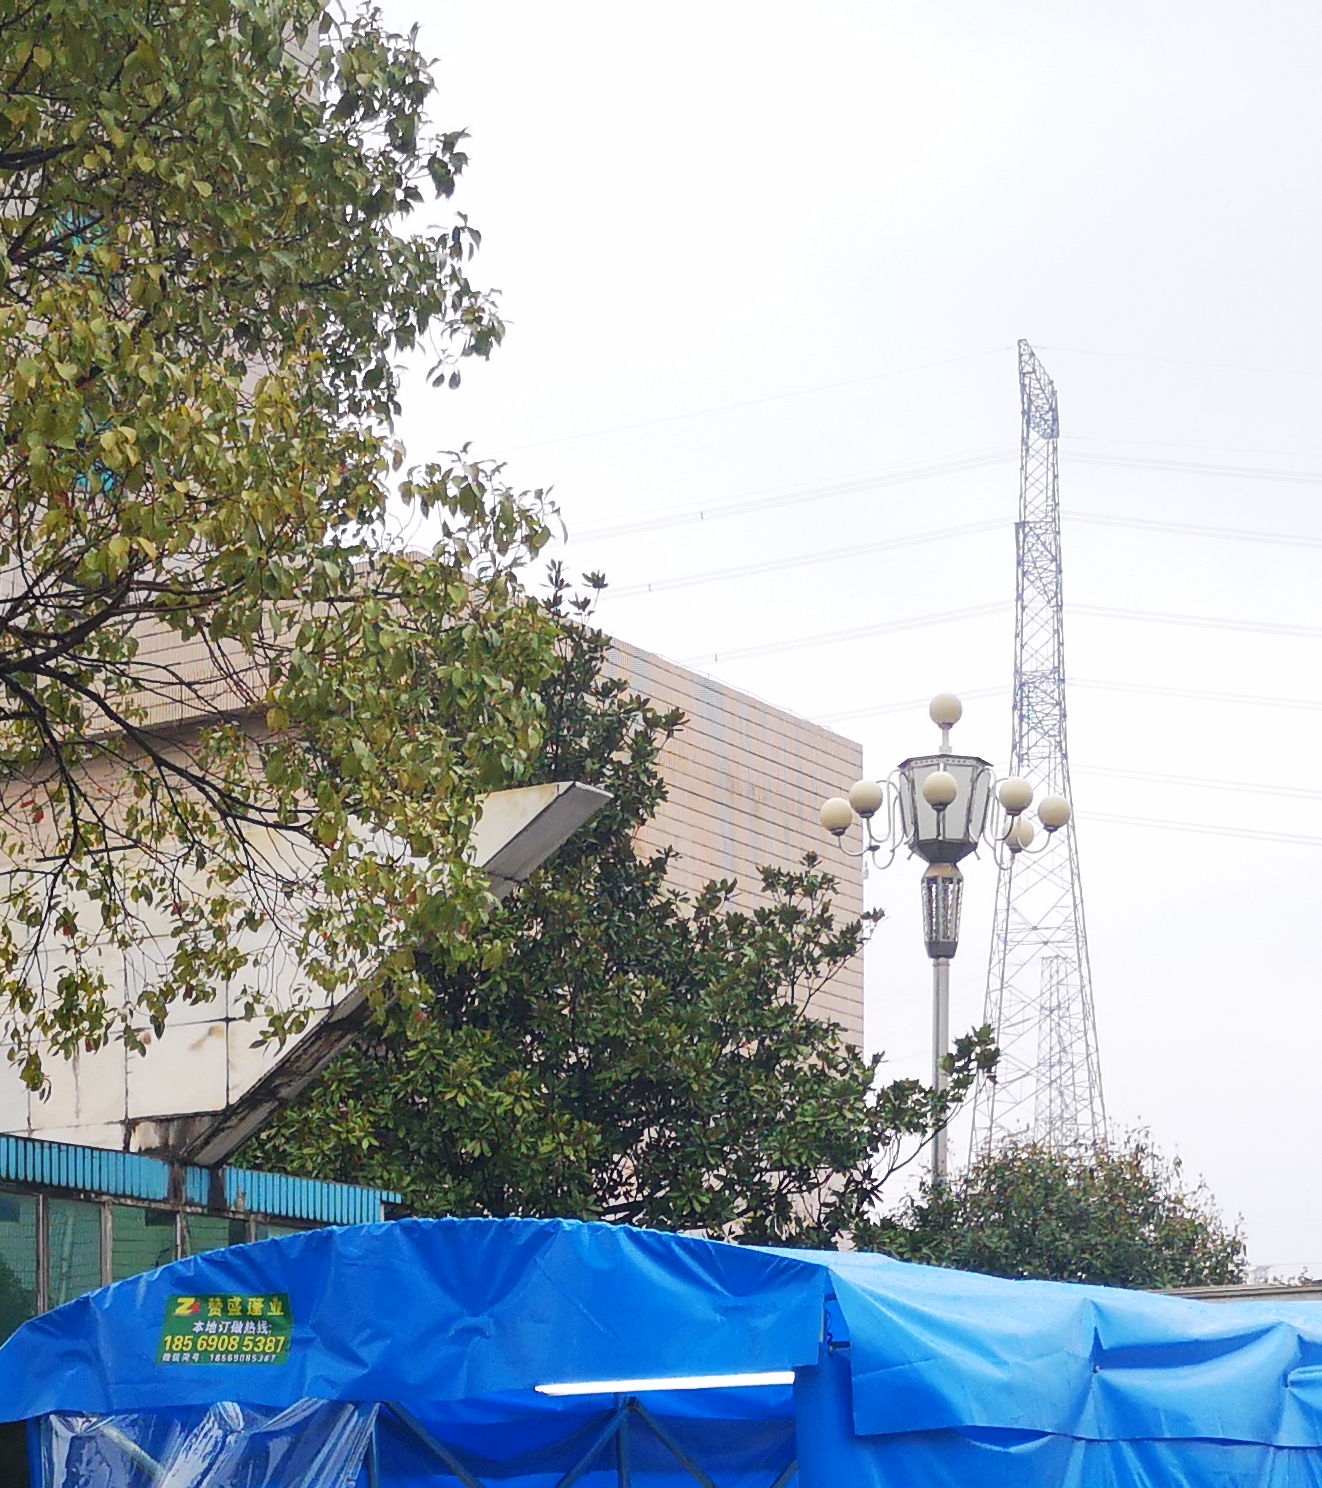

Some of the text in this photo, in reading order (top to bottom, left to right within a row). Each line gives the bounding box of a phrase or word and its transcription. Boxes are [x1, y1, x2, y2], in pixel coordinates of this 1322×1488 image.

[163, 1335, 285, 1353] 185 6908 5387
